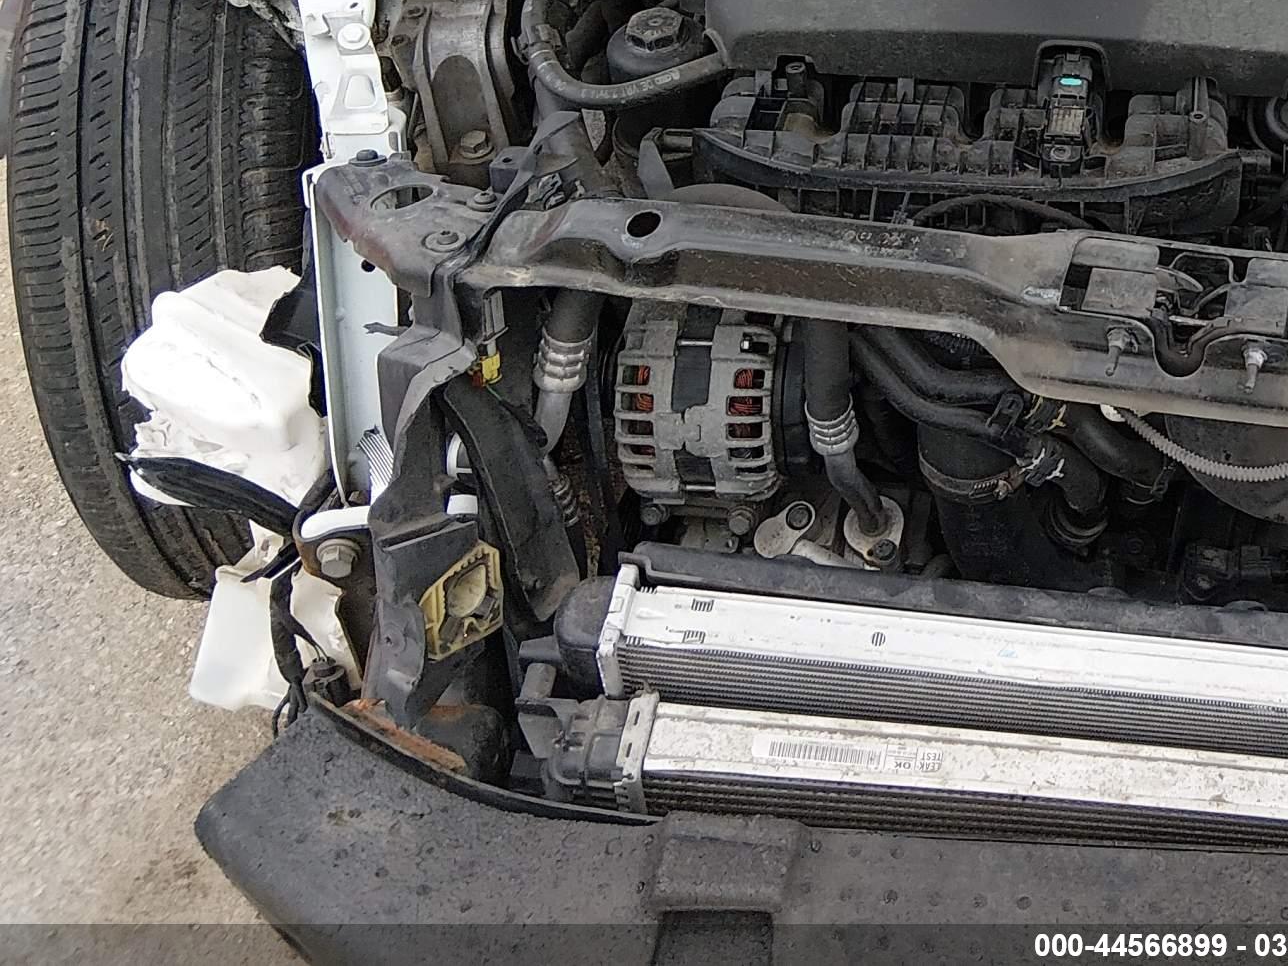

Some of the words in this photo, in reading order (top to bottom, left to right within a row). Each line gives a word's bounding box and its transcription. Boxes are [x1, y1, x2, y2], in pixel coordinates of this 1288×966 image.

[920, 750, 943, 762] TEST
[893, 760, 911, 770] OK
[918, 761, 942, 772] LEAK
